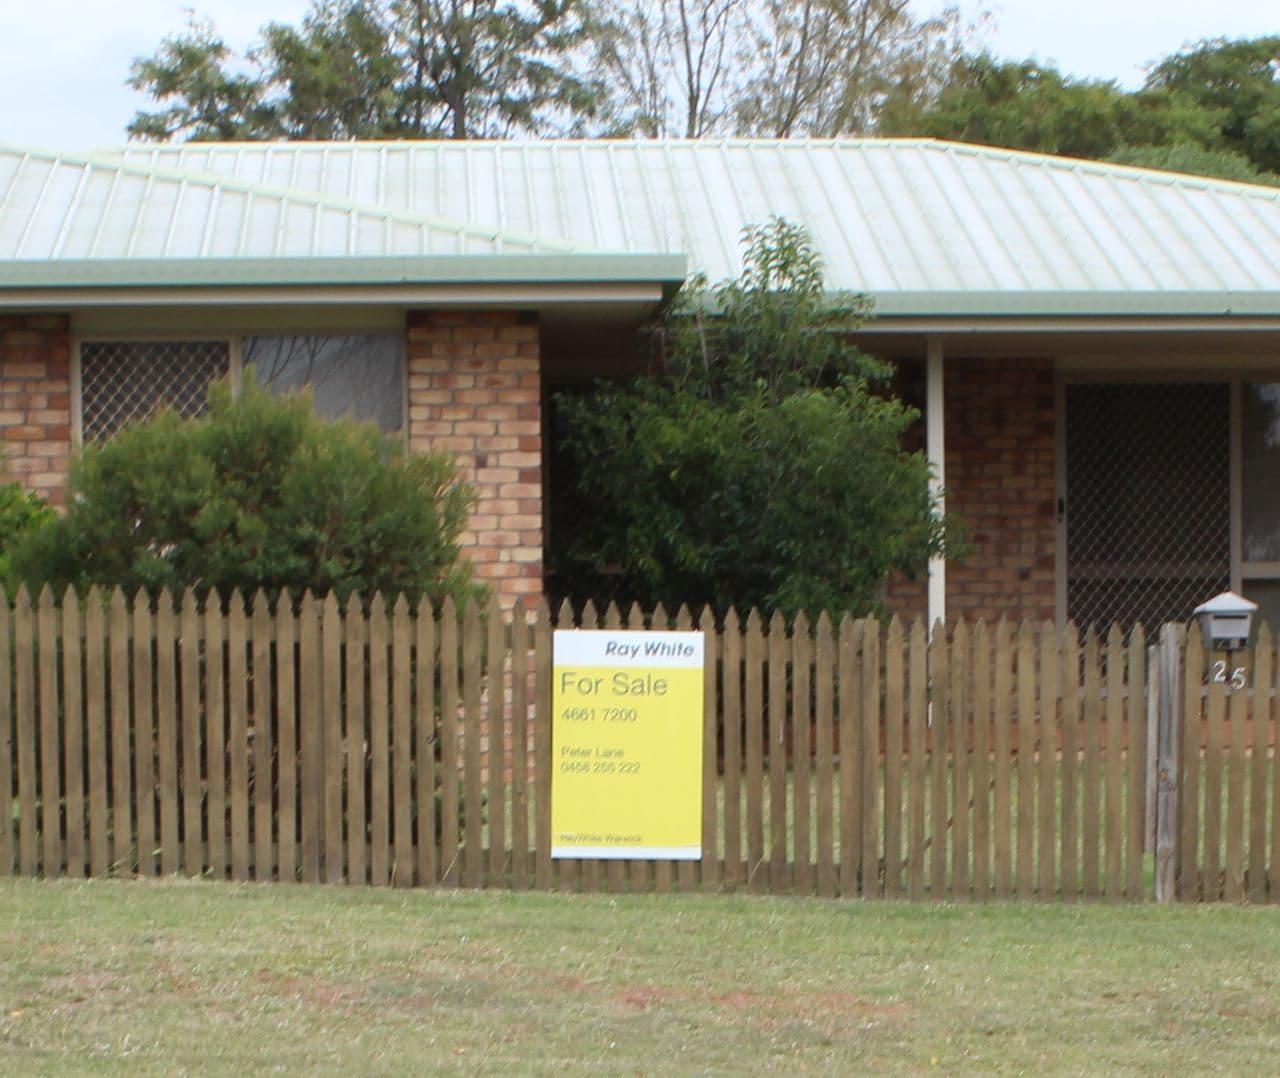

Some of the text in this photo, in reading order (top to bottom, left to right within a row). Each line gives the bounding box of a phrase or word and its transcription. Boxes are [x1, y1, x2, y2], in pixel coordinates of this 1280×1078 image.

[605, 640, 695, 660] Ray White
[561, 671, 668, 696] For Sale
[1213, 660, 1247, 690] 25
[561, 707, 638, 722] 4661 7200
